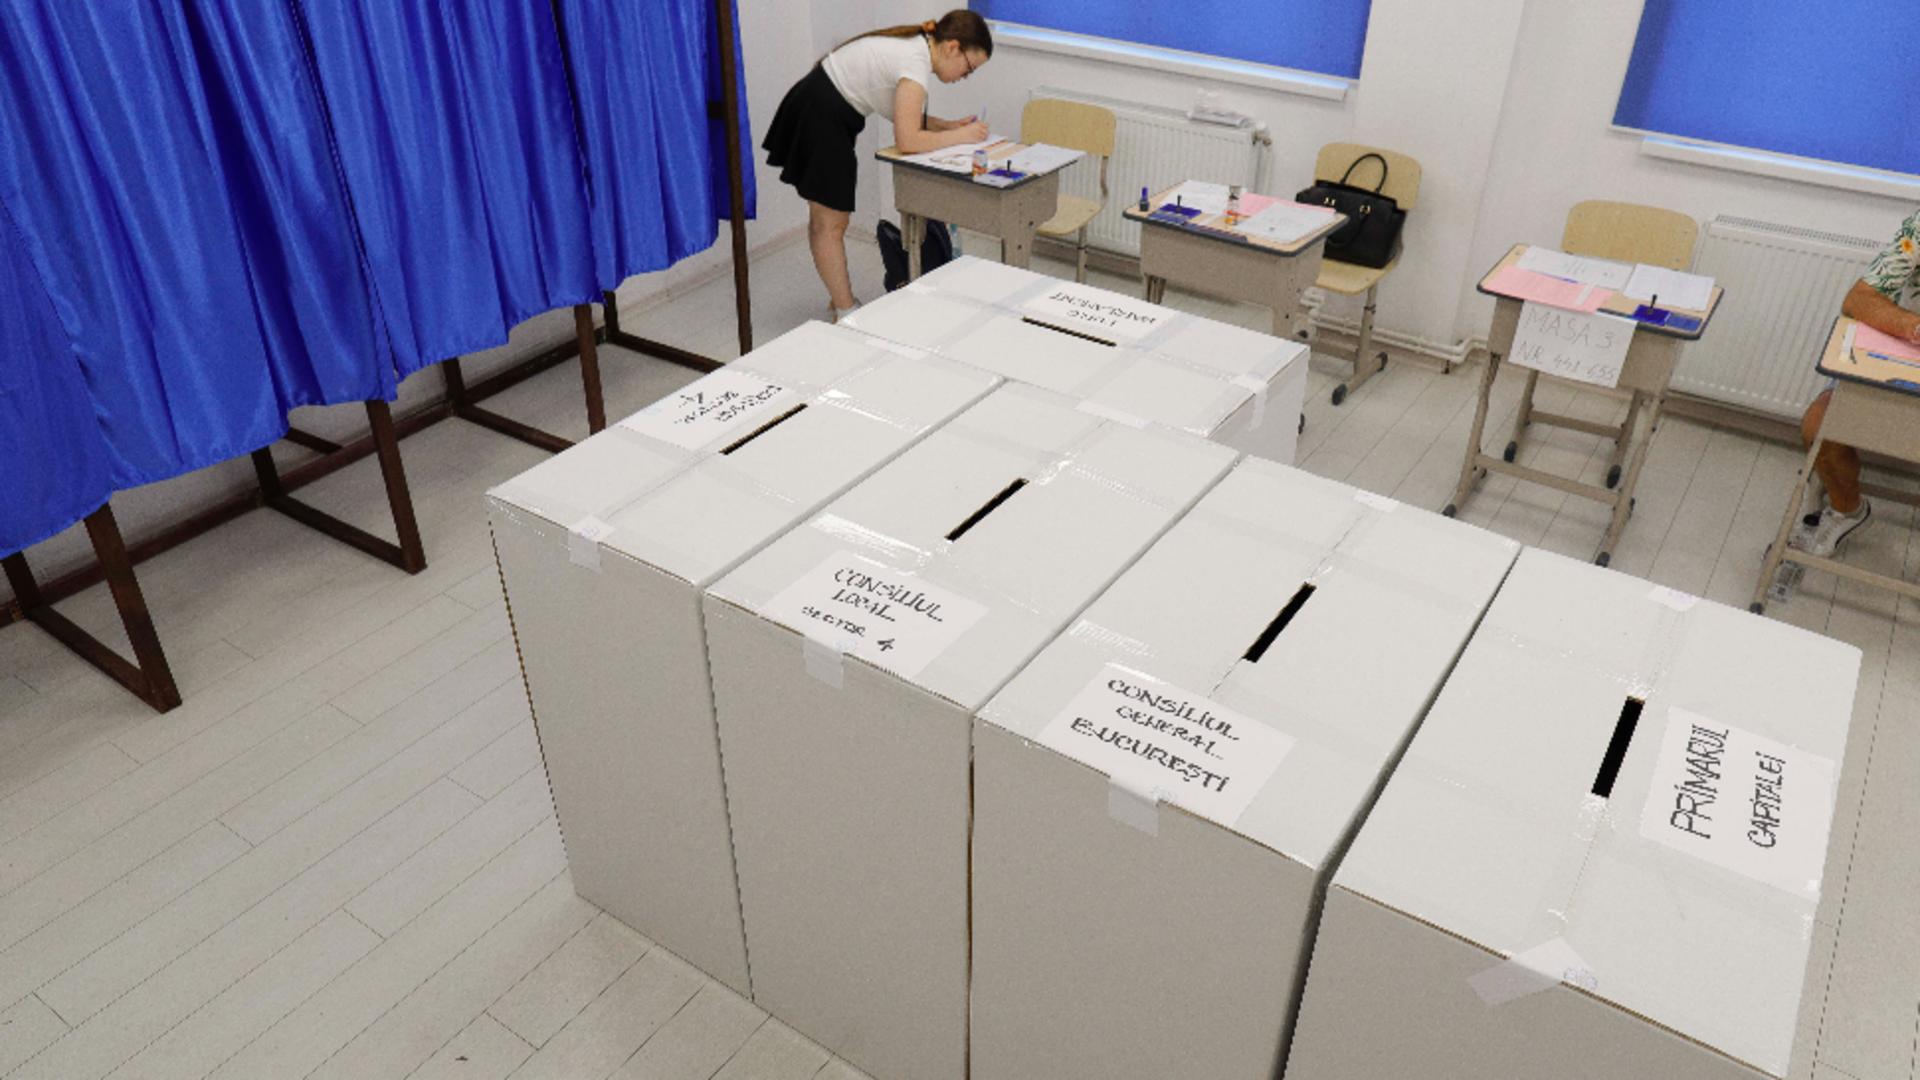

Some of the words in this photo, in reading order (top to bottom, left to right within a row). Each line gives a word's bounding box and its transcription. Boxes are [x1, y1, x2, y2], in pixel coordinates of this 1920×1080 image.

[1523, 306, 1591, 346] MASA
[1595, 331, 1616, 351] 3
[1517, 340, 1545, 365] NR
[831, 588, 897, 623] LOCAL
[802, 606, 867, 638] SECTOR
[876, 637, 896, 652] 4
[1115, 705, 1225, 761] GENERAL
